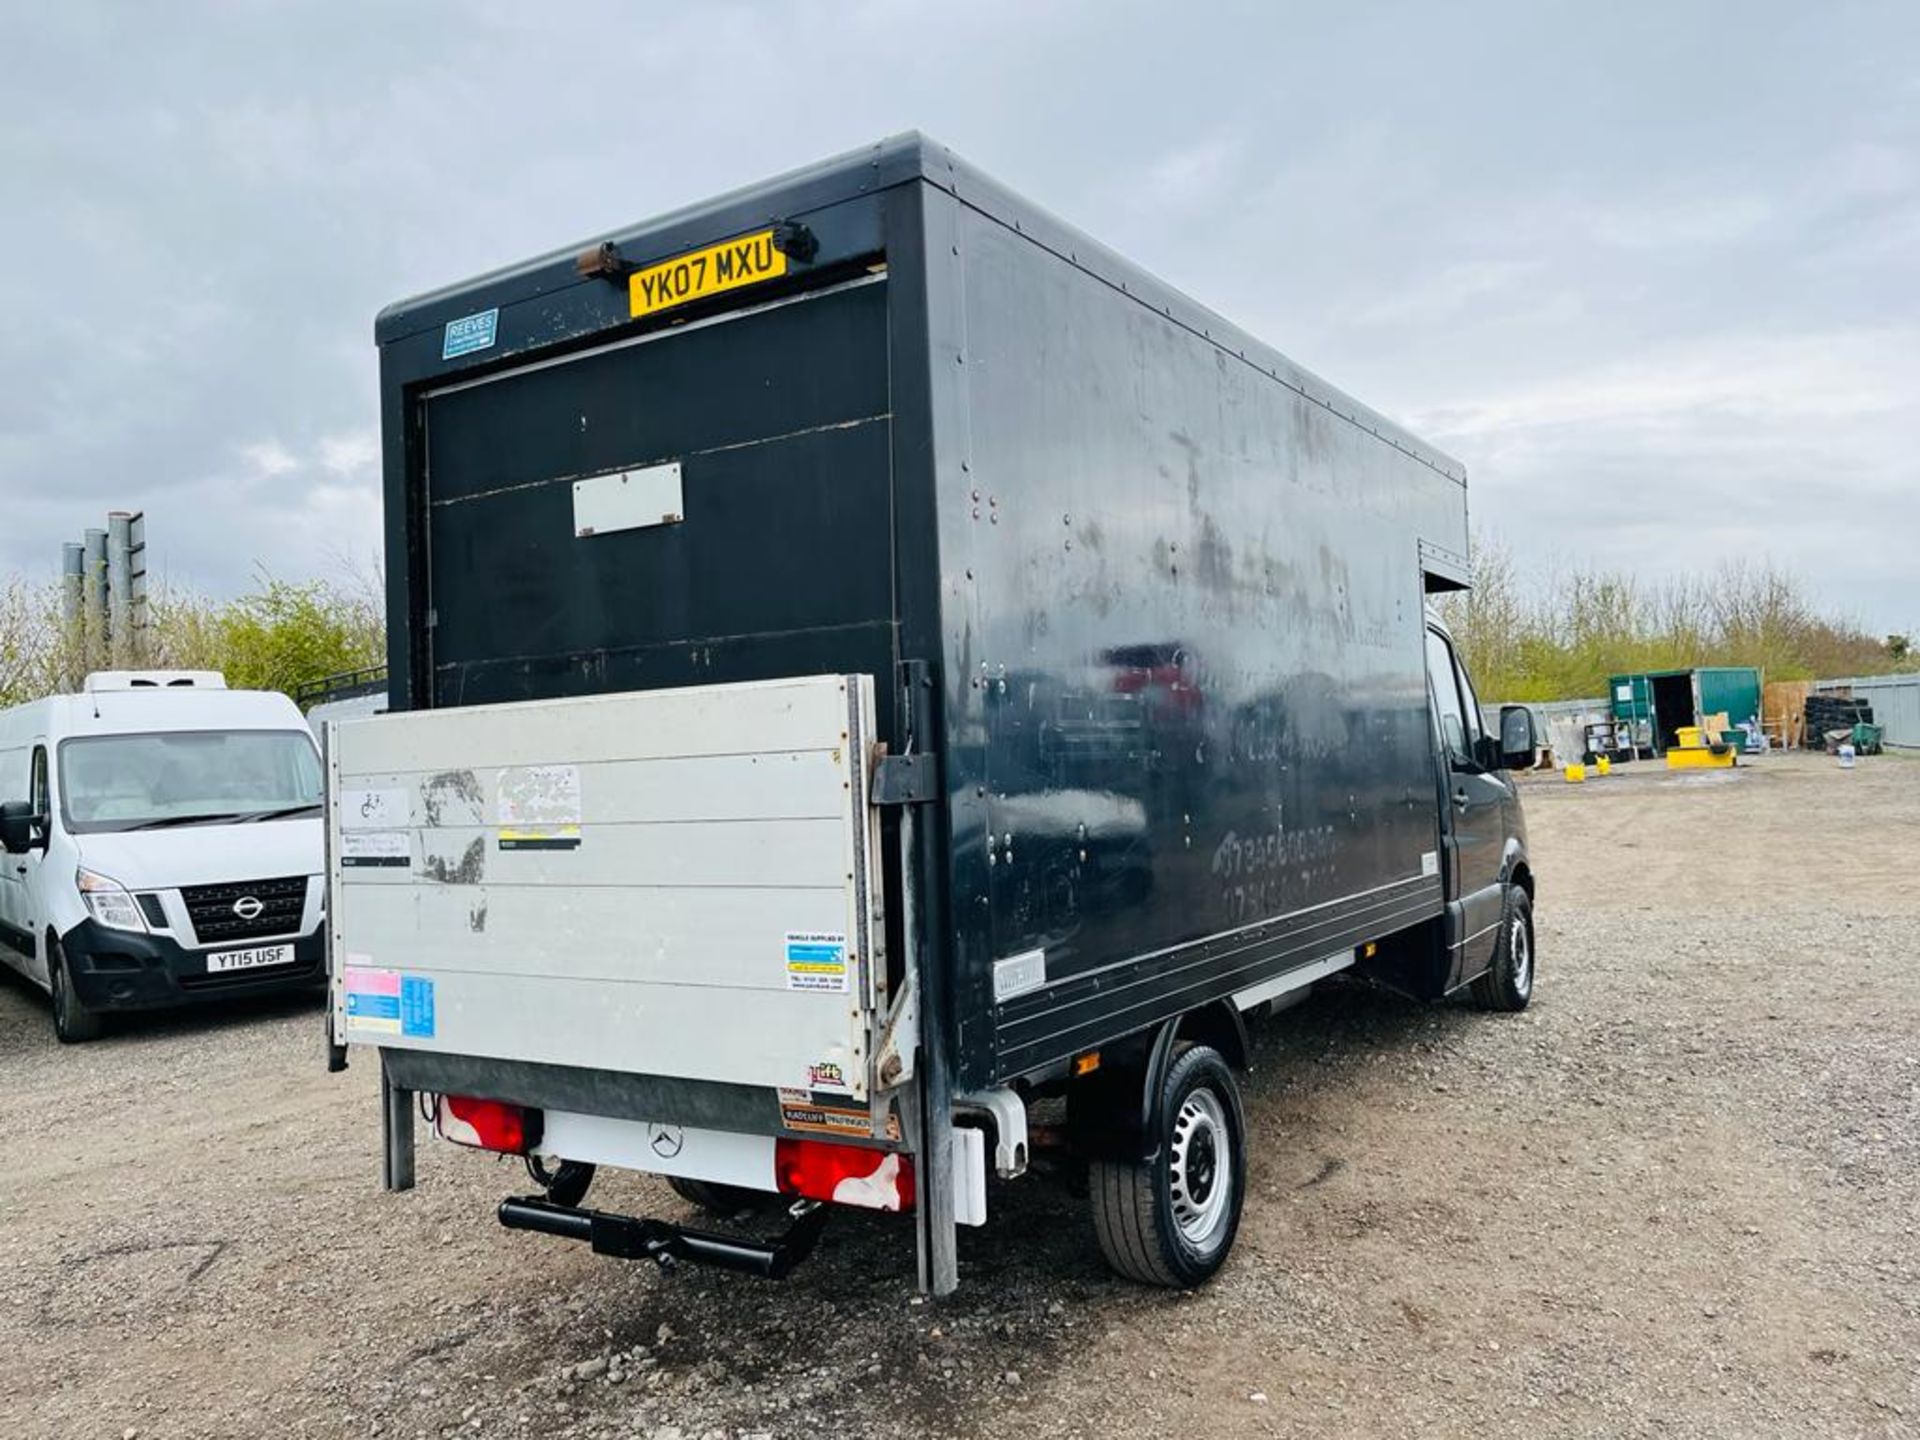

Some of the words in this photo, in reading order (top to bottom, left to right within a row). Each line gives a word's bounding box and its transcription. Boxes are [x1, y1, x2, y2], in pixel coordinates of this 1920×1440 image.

[640, 256, 709, 309] YK07
[715, 241, 774, 285] MXU
[449, 314, 493, 338] REEVES
[218, 952, 252, 968] YT15
[256, 947, 285, 963] USF
